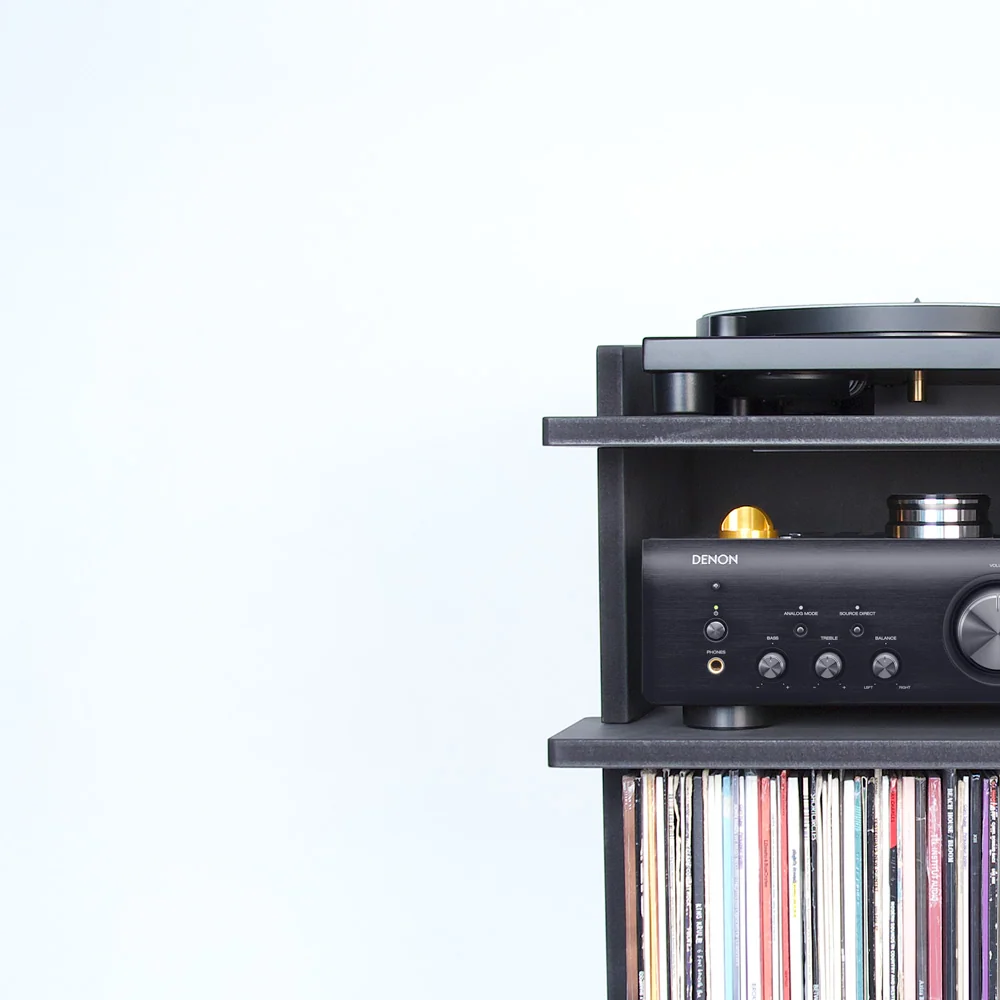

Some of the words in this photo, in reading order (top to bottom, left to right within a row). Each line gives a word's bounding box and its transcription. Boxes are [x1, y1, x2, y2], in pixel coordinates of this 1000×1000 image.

[692, 554, 738, 565] DENON
[930, 880, 940, 902] AUDIO
[695, 921, 704, 944] KRULE
